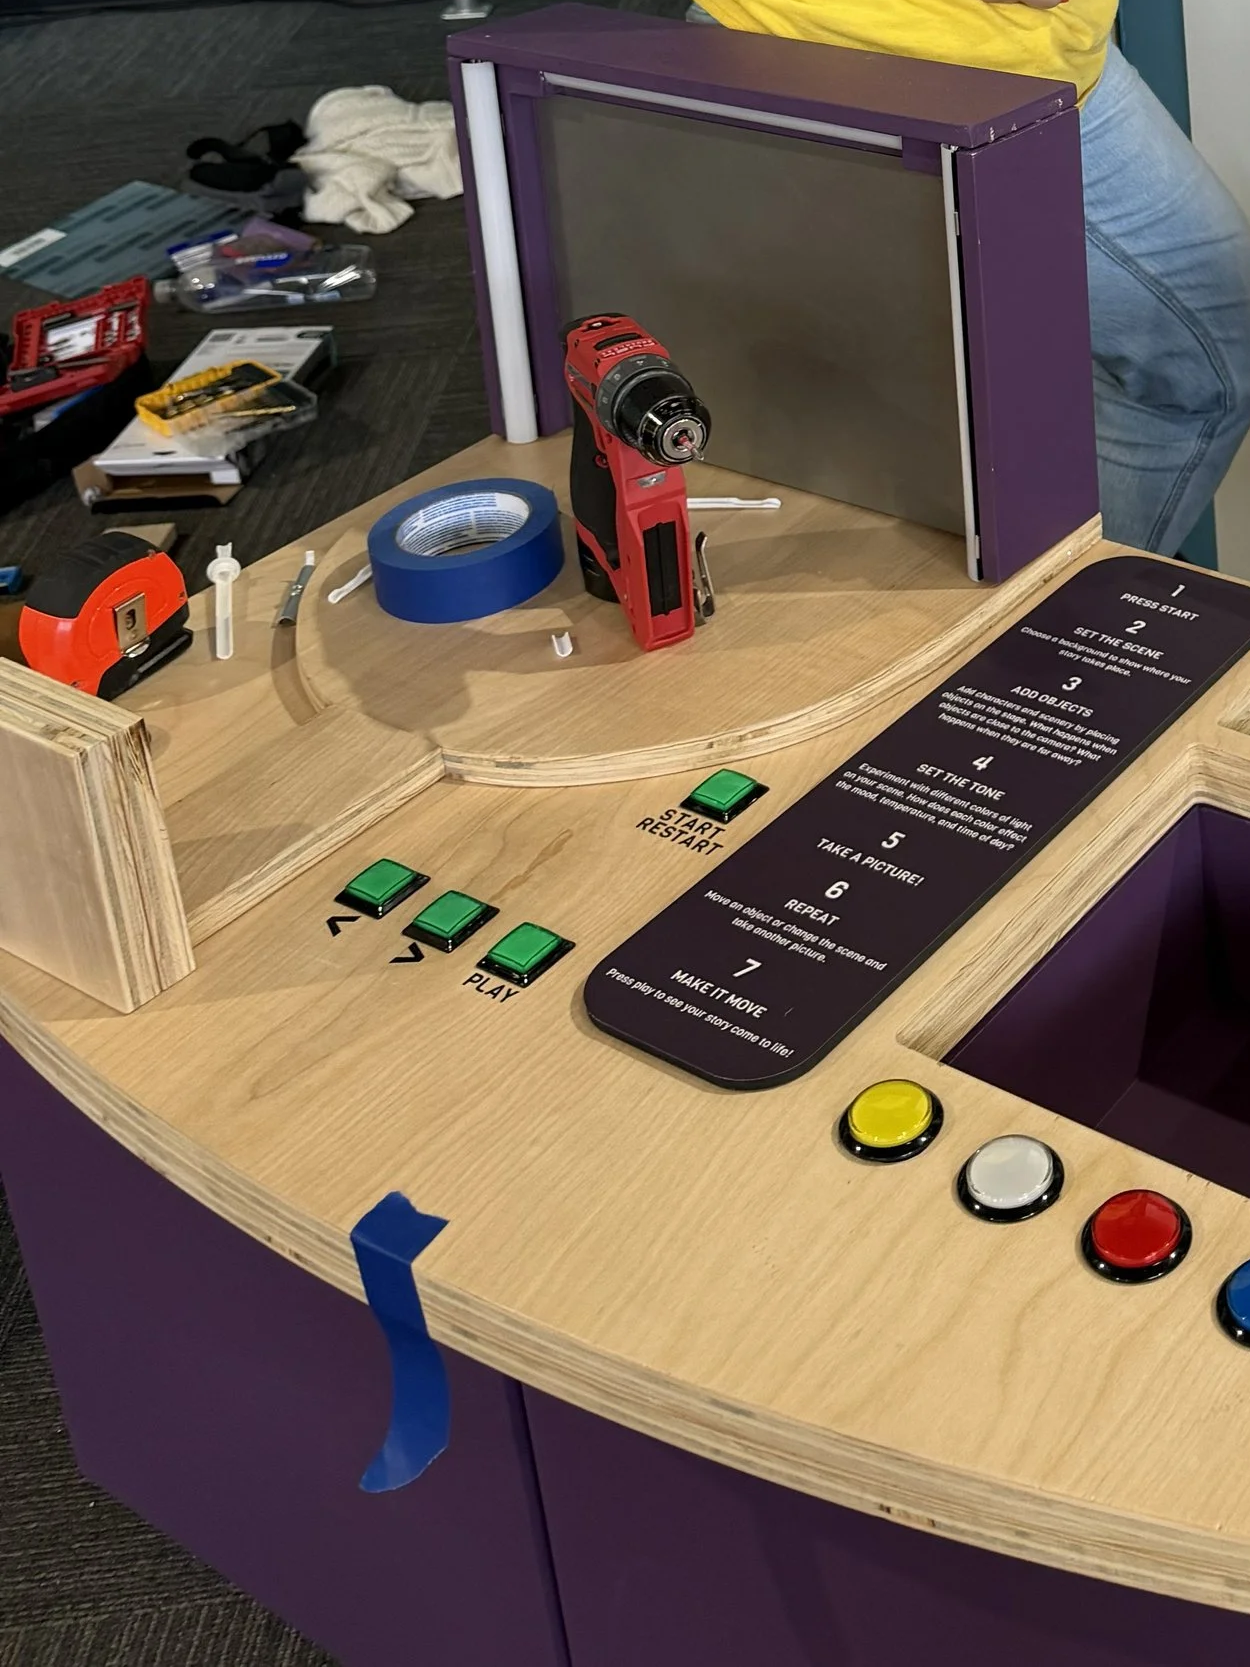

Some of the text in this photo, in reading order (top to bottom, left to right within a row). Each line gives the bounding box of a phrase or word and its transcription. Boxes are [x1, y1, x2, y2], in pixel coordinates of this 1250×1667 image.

[1120, 593, 1199, 620] PRESS START
[1172, 585, 1185, 596] 1
[1073, 627, 1164, 659] SET THE SCENE
[1126, 621, 1146, 634] 2
[1020, 626, 1051, 640] Choose
[1058, 638, 1109, 658] background
[1118, 658, 1142, 668] show
[1142, 665, 1170, 678] where
[1168, 674, 1191, 684] your
[1058, 649, 1130, 676] story takes place.
[1010, 685, 1093, 717] ADD OBJECTS
[1062, 677, 1082, 690] 3
[938, 702, 1101, 761] objects are close to the camera? What
[941, 691, 1117, 755] objects on the stage. What happens when
[956, 685, 1120, 745] Add characters and scenery by placing
[938, 712, 1082, 766] happens when they are far away?
[916, 763, 1005, 800] SET THE TONE
[973, 756, 993, 770] 4
[835, 780, 1014, 850] the mood, temperature, and time of day?
[843, 771, 1027, 842] on your scene. How does each color effect
[858, 762, 910, 786] Experiment
[909, 782, 930, 793] with
[929, 789, 970, 808] different
[969, 804, 999, 818] colors
[1008, 817, 1032, 831] light
[636, 817, 724, 855] RESTART
[659, 809, 726, 839] START
[882, 832, 905, 848] 5
[817, 838, 924, 886] TAKE A PICTURE!
[825, 881, 849, 898] 6
[704, 890, 887, 970] Move an object or change the scene and
[784, 898, 840, 925] REPEAT
[731, 917, 825, 962] take another picture.
[733, 959, 761, 977] 7
[462, 972, 520, 1003] PLAY
[670, 969, 767, 1018] MAKE IT MOVE
[605, 968, 794, 1057] Press play to see your story come to life!
